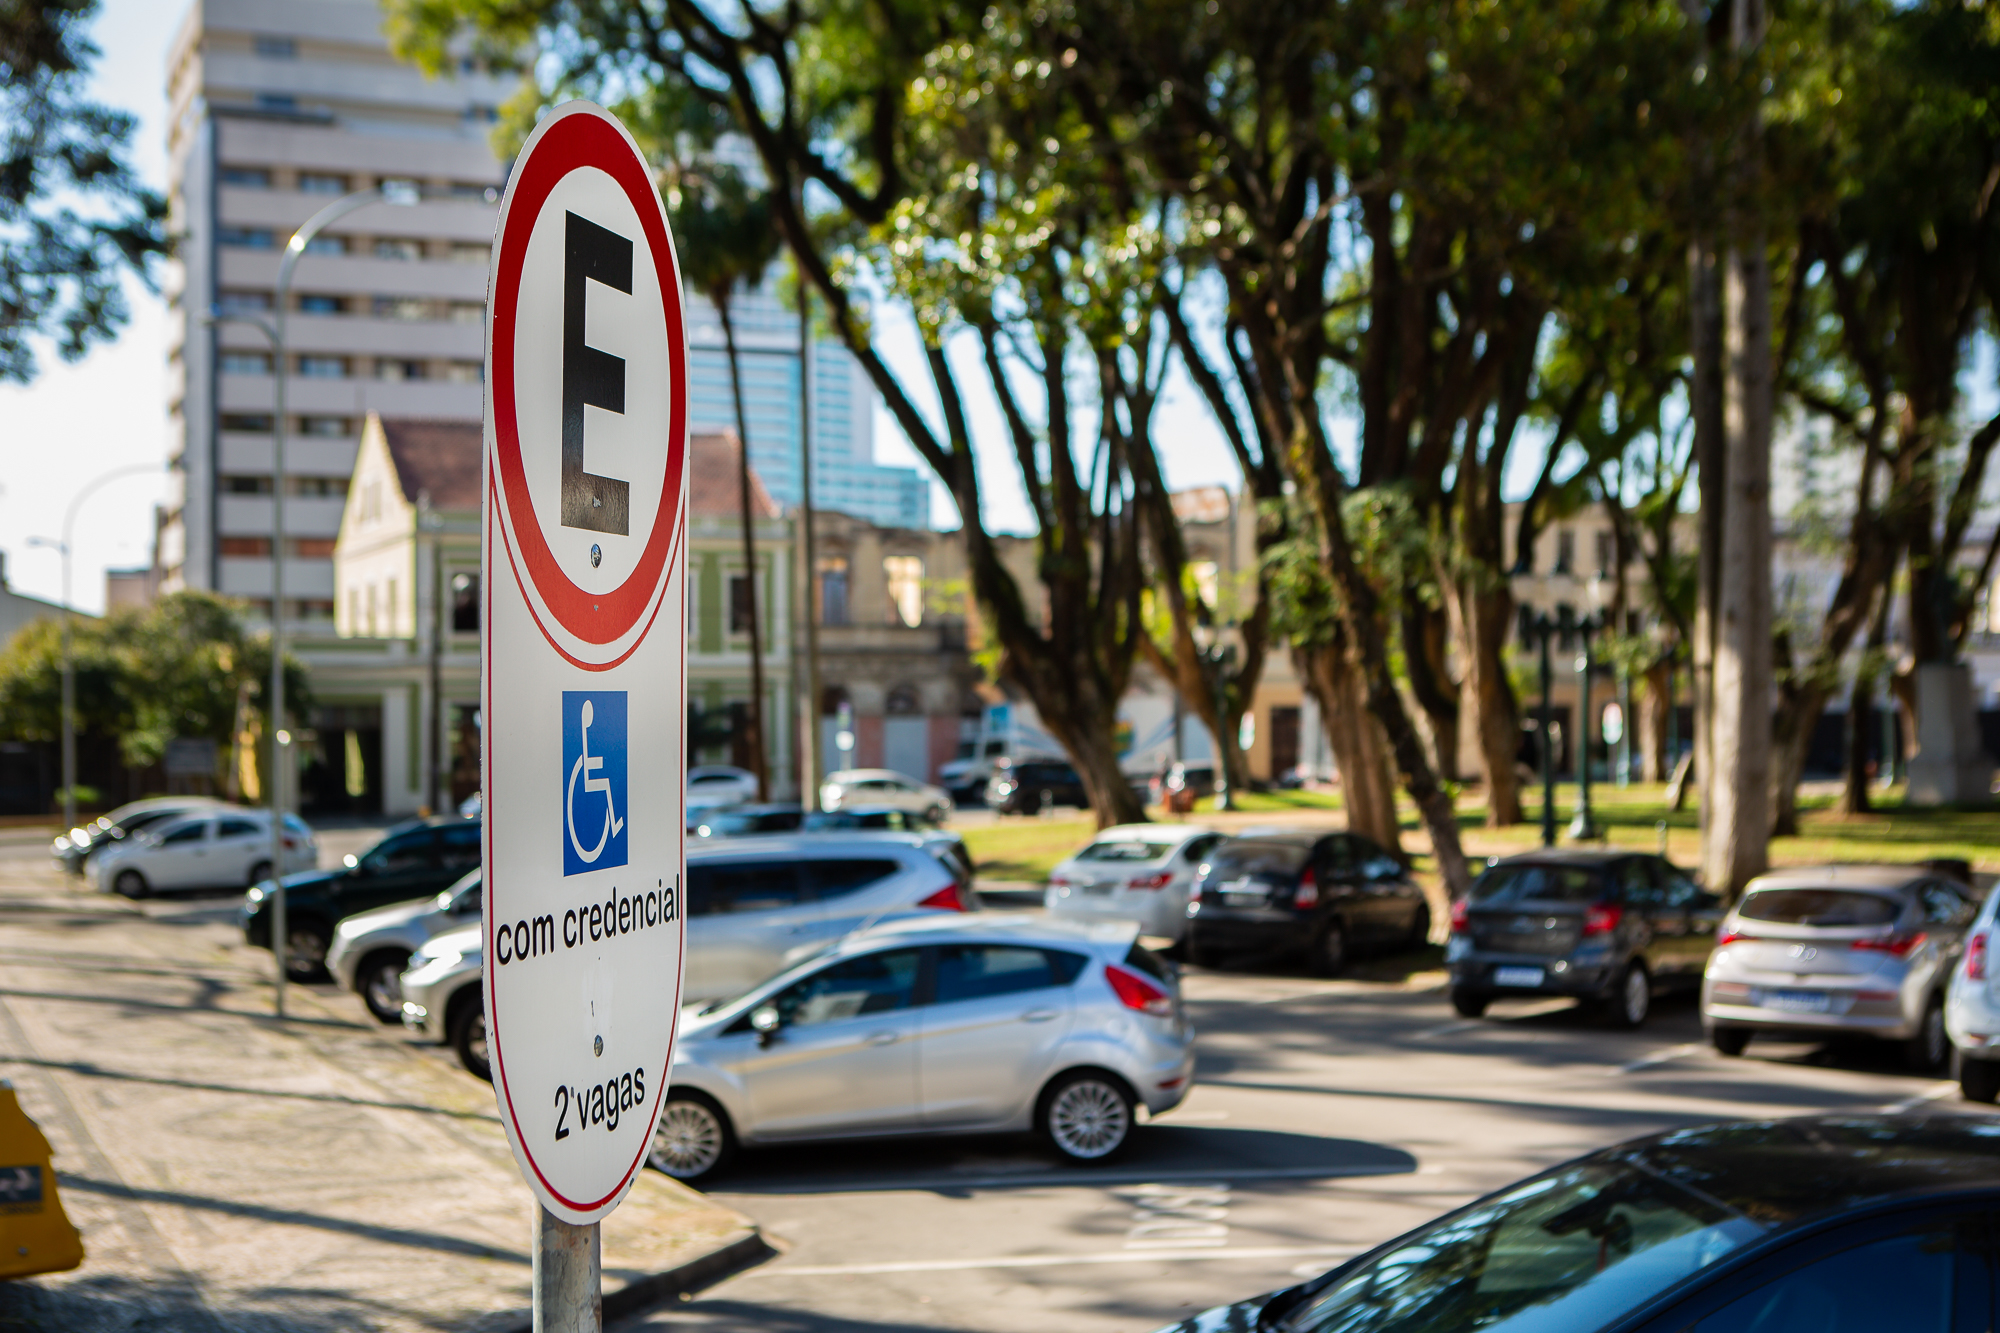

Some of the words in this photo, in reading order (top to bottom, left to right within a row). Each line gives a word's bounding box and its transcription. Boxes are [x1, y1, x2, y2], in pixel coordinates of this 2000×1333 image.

[561, 209, 634, 537] E
[496, 913, 555, 966] com
[563, 873, 679, 949] credencial
